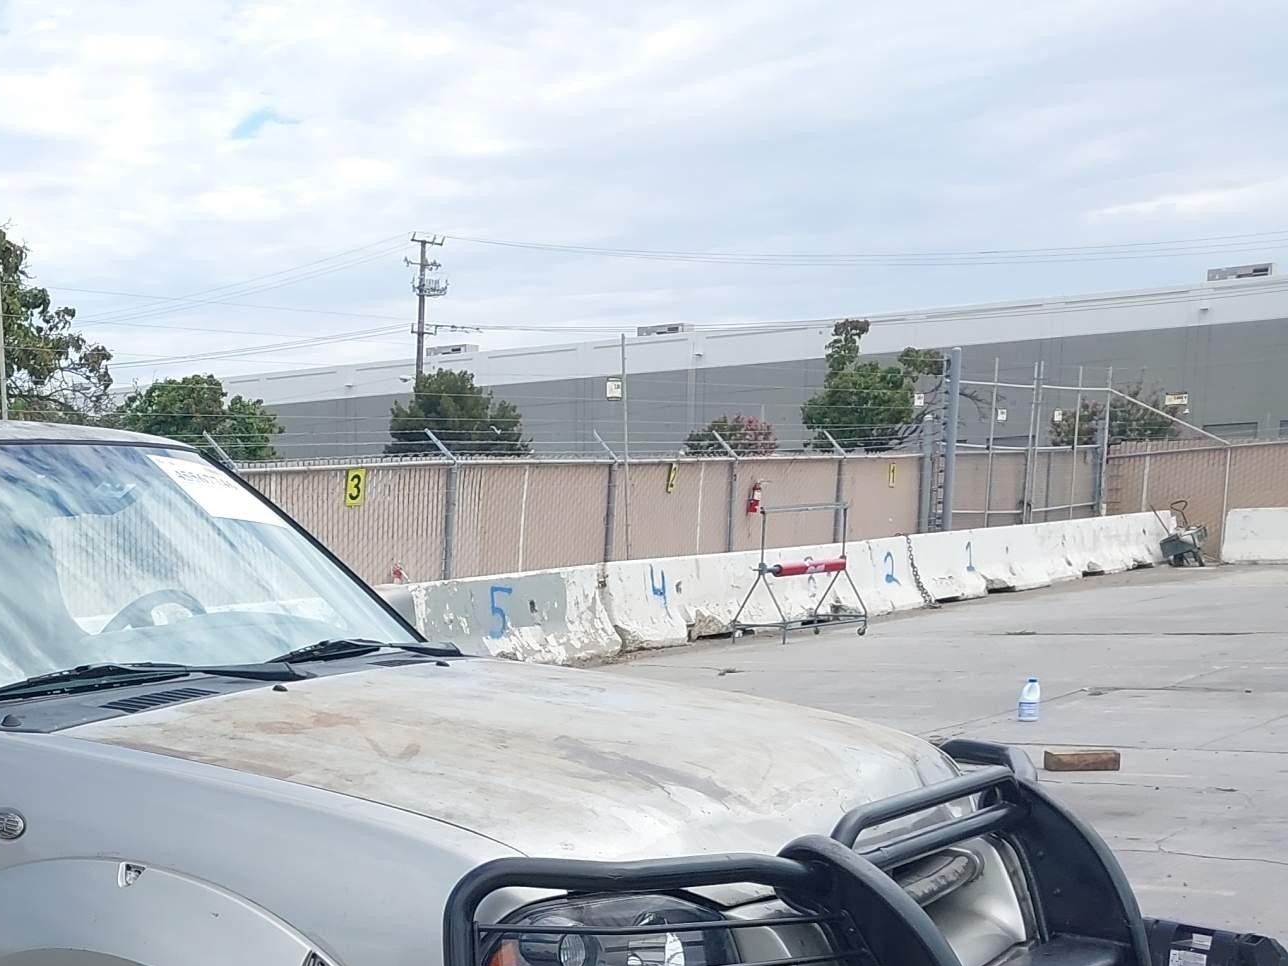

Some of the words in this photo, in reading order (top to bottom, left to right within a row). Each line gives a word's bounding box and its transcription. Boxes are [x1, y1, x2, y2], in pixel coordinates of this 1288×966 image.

[349, 473, 362, 501] 3
[884, 551, 902, 586] 2
[489, 585, 513, 640] 5
[649, 564, 673, 620] 4
